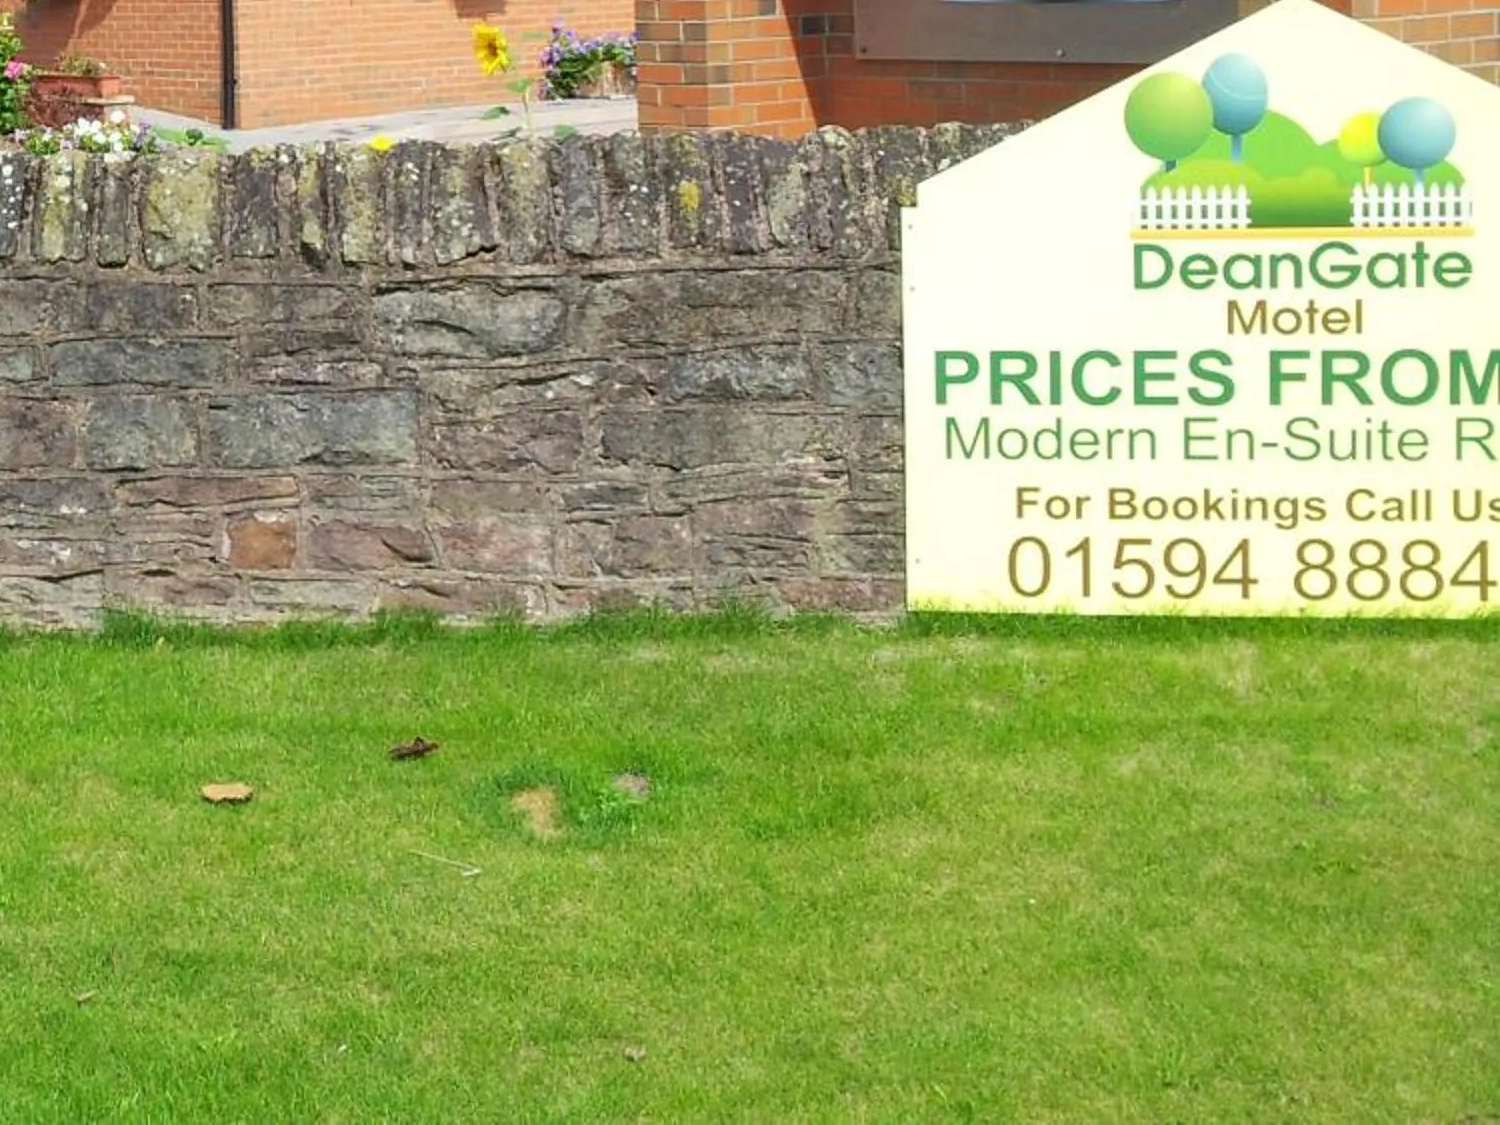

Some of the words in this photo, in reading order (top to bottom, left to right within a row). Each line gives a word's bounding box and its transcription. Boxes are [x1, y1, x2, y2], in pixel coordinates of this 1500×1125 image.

[1134, 241, 1473, 290] DeanGate
[1227, 299, 1363, 335] Motel
[935, 350, 1235, 406] PRICES
[1269, 349, 1500, 406] FROM
[946, 417, 1156, 460] Modern
[1183, 417, 1429, 461] En-Suite
[1016, 487, 1091, 520] For
[1108, 488, 1327, 530] Bookings
[1346, 488, 1432, 522] Call
[1008, 536, 1259, 600] 01594
[1293, 538, 1498, 602] 8884
